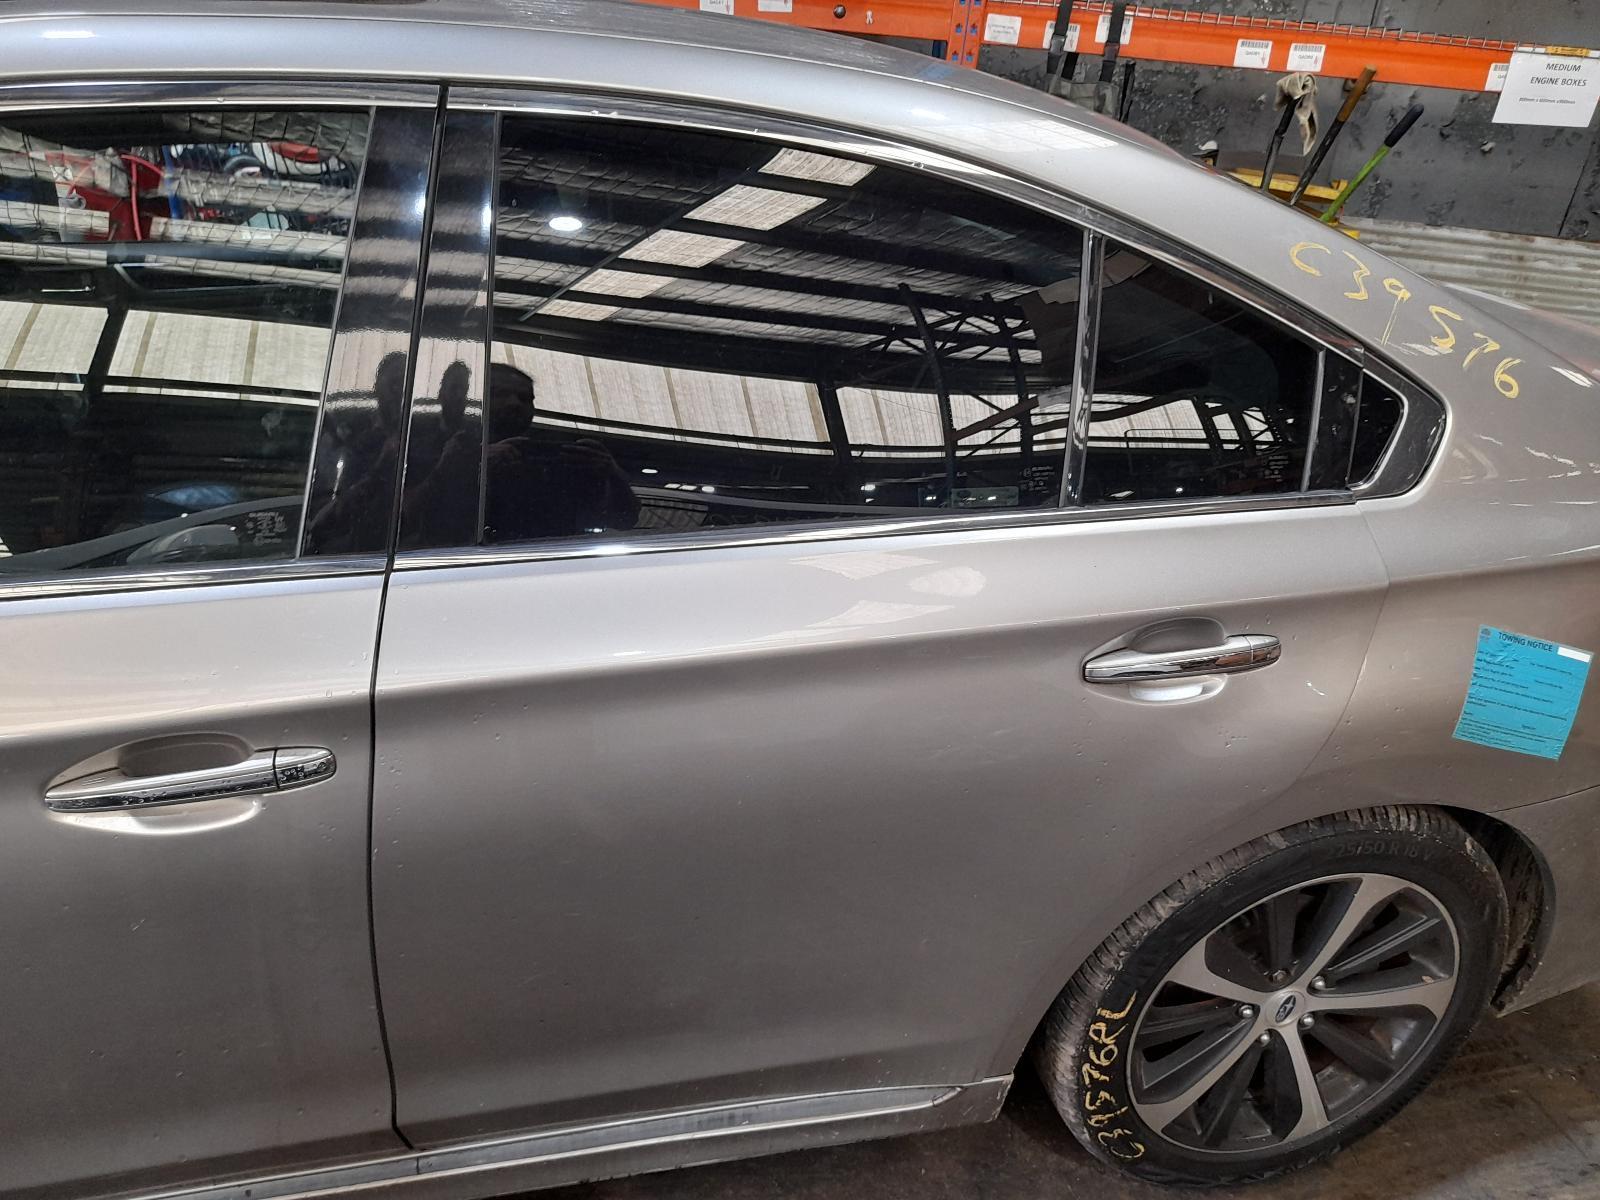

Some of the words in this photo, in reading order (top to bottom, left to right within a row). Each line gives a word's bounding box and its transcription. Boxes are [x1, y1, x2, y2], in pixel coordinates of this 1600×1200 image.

[1545, 63, 1582, 72] MEDIUM
[1530, 76, 1561, 86] ENGINE
[1561, 78, 1588, 87] BOXES
[1498, 631, 1526, 646] TOWING
[1527, 639, 1553, 653] NOTICE
